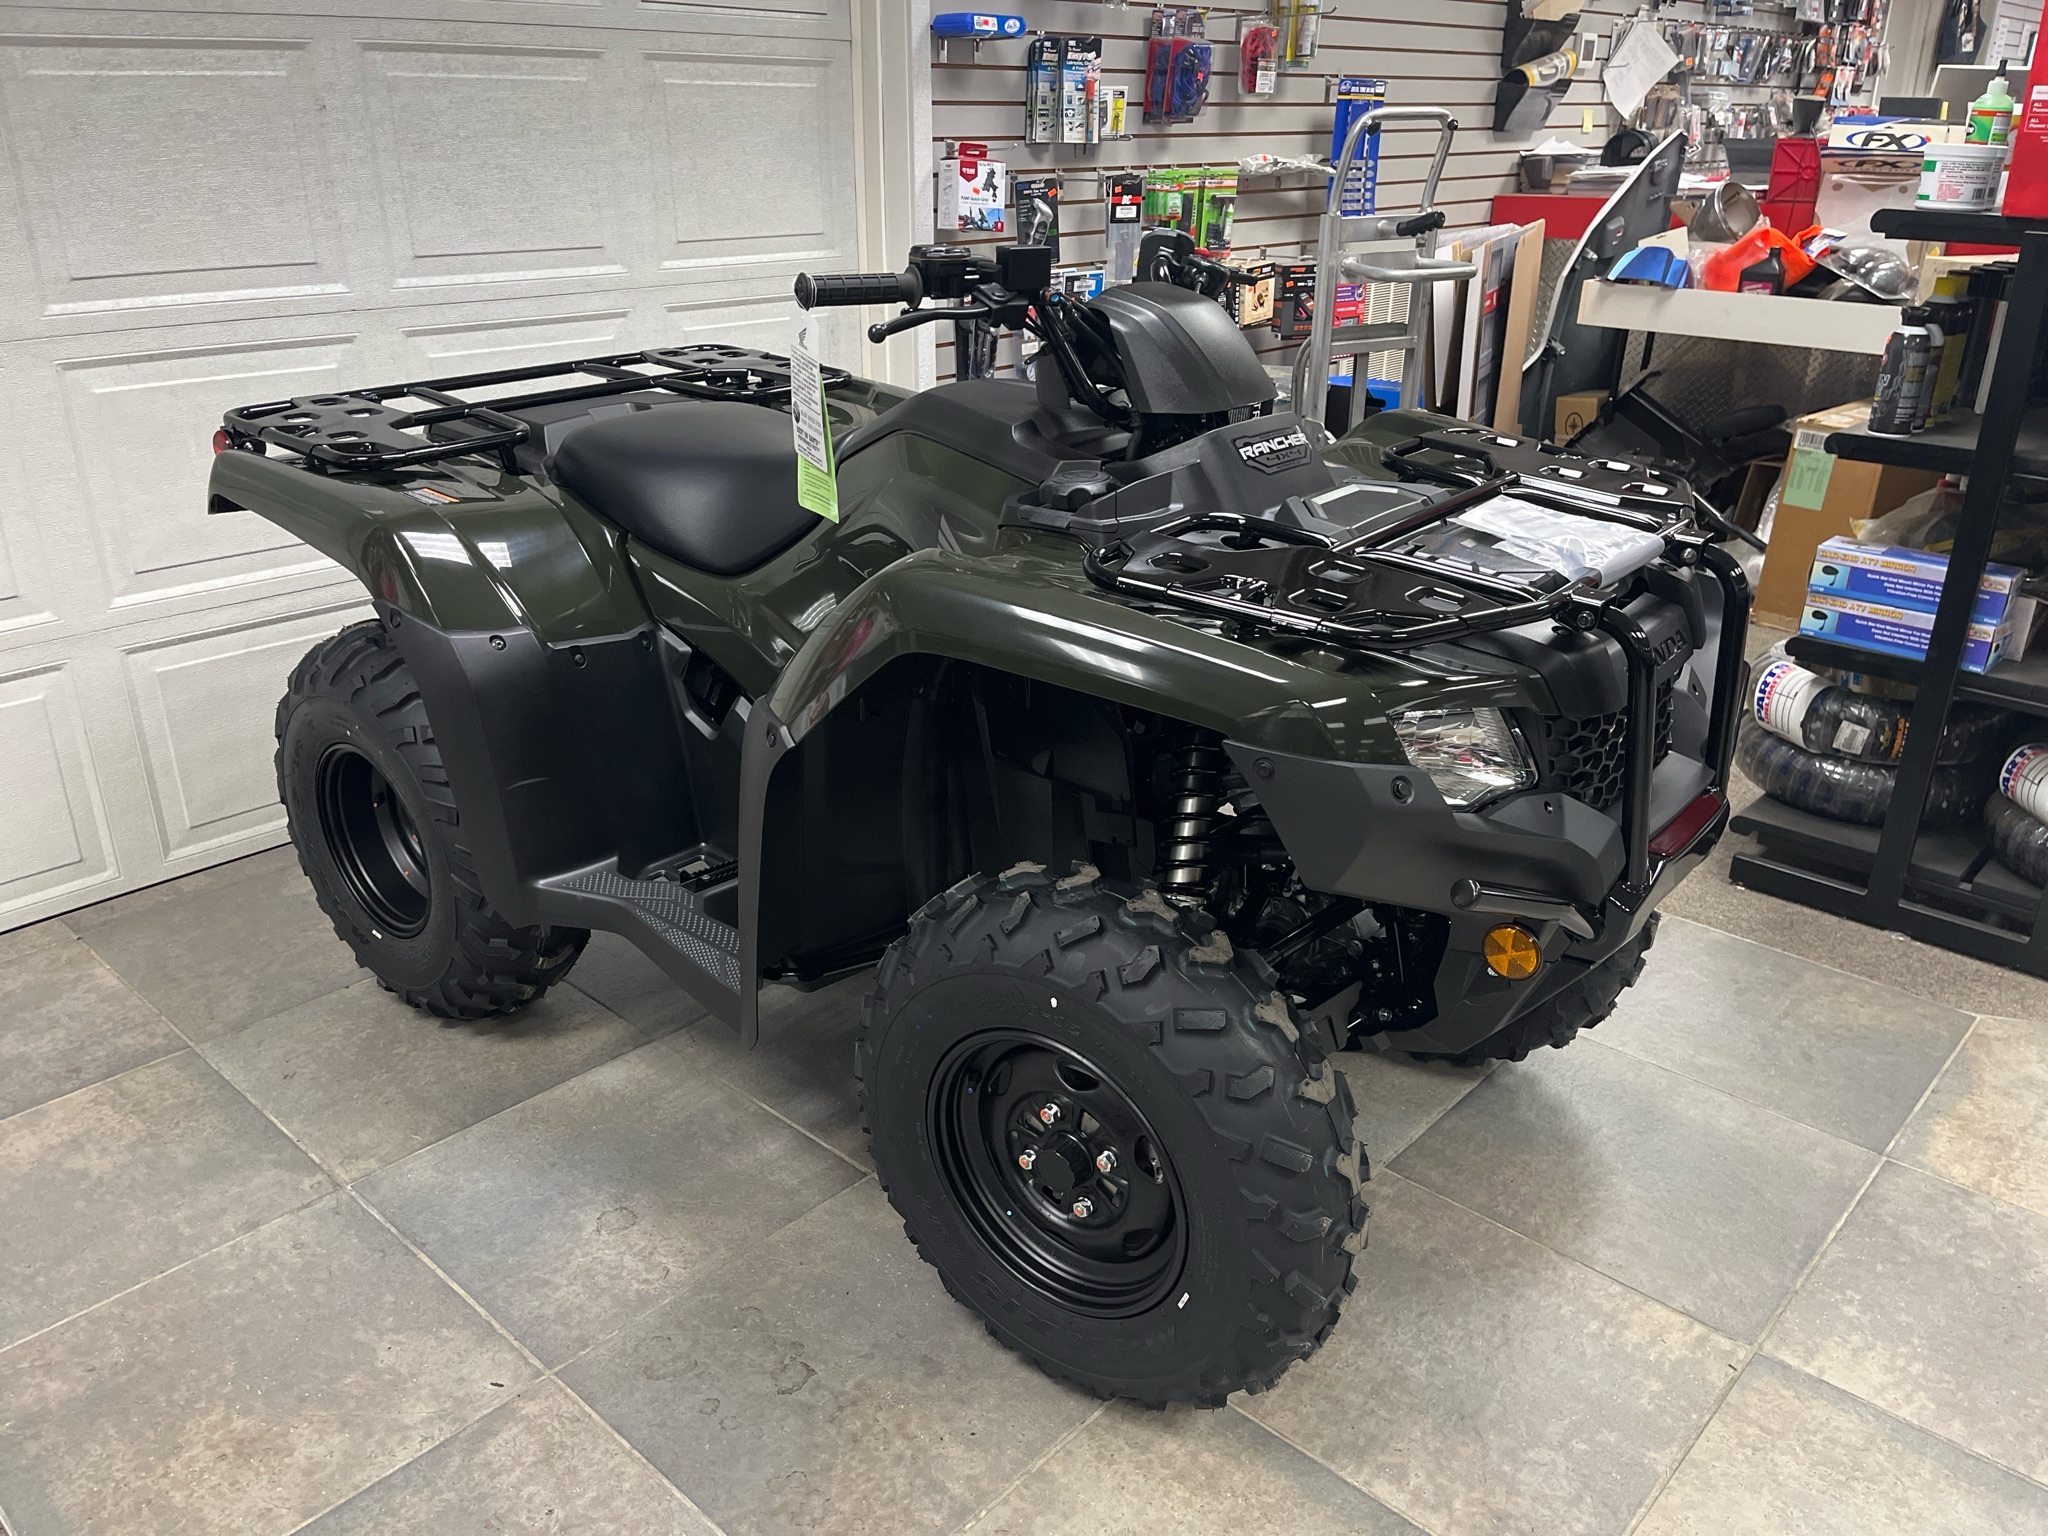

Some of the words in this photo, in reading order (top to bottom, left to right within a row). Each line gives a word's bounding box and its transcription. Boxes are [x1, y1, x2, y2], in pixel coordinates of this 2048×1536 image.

[1861, 132, 1914, 151] FX
[1238, 432, 1307, 461] RANCHER
[1860, 556, 1879, 567] ATV
[1880, 560, 1917, 573] MIRROR
[1849, 602, 1867, 613] ATV
[1867, 606, 1903, 620] MIRROR
